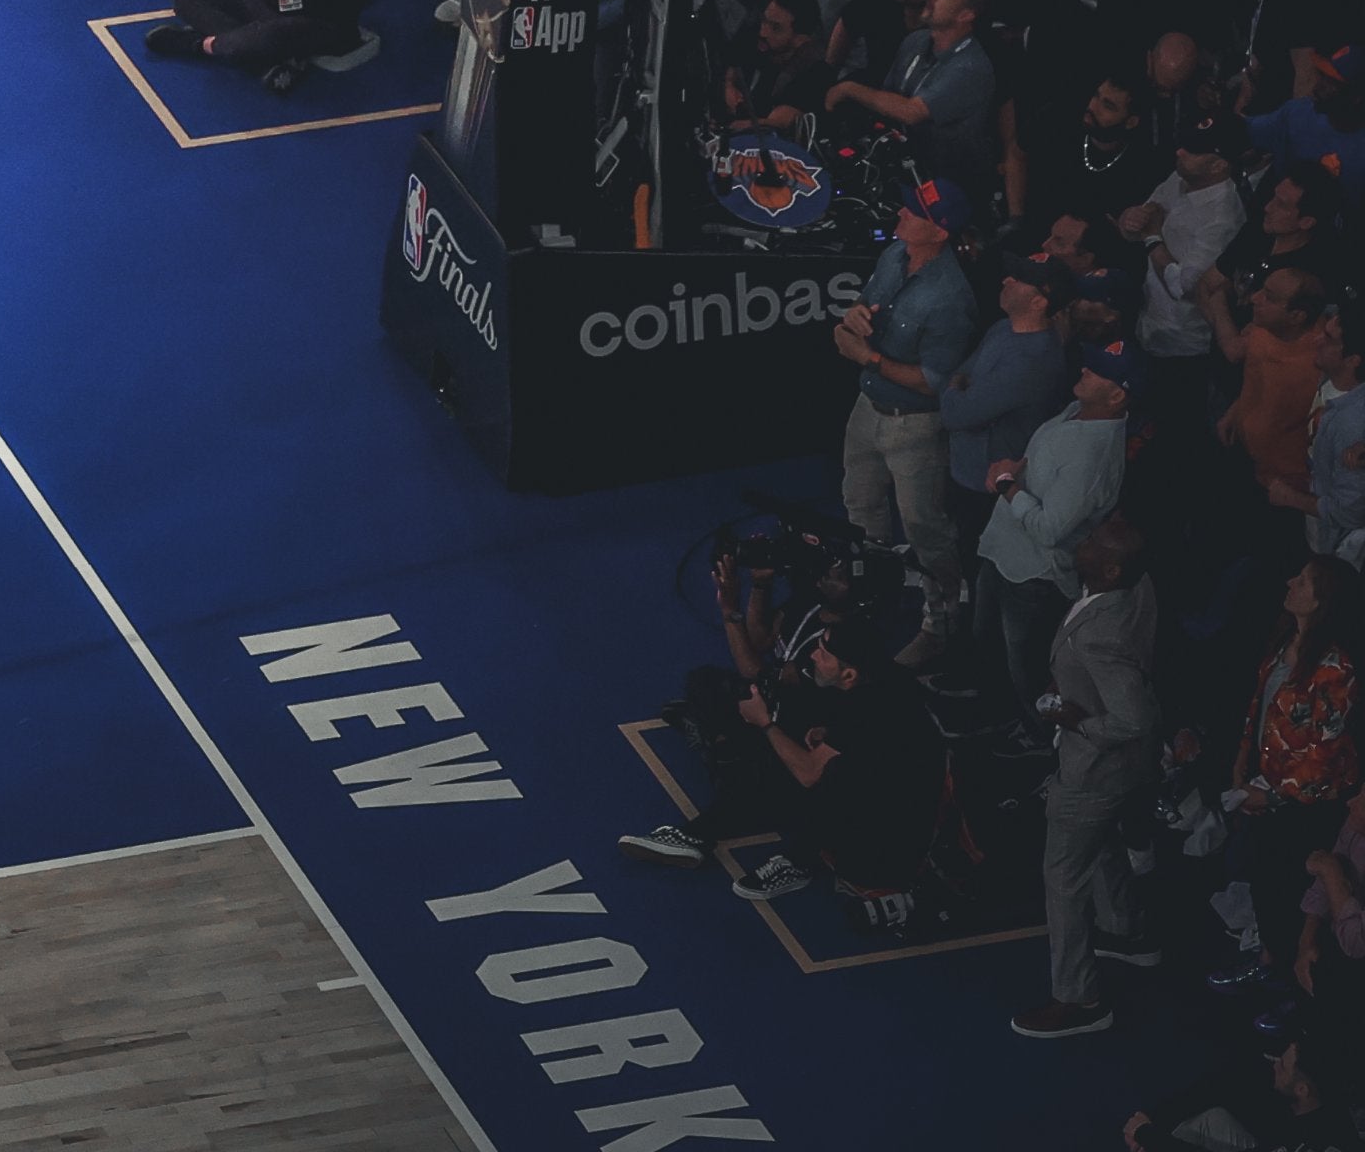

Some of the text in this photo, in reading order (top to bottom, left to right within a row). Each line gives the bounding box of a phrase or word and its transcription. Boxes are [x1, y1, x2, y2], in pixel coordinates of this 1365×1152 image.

[535, 5, 586, 54] App
[410, 207, 498, 351] Finals
[579, 271, 863, 357] coinbas
[239, 613, 524, 808] NEW
[425, 859, 775, 1152] YORK
